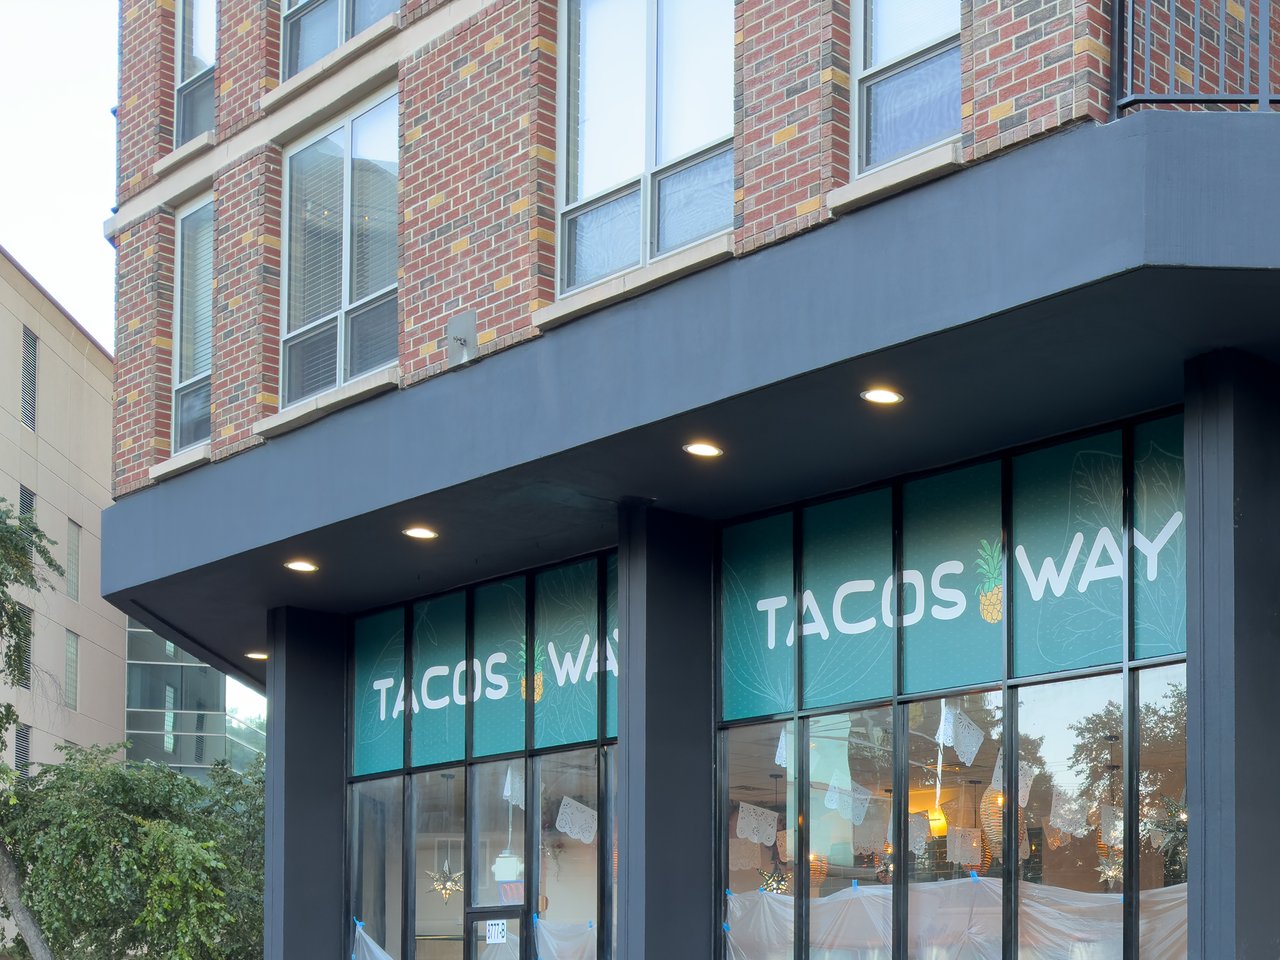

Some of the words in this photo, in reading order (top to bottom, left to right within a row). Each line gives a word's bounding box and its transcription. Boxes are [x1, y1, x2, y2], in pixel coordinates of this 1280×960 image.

[757, 560, 967, 649] TACOS
[1015, 511, 1183, 601] WAY
[373, 652, 509, 721] TACOS
[547, 628, 619, 687] WA
